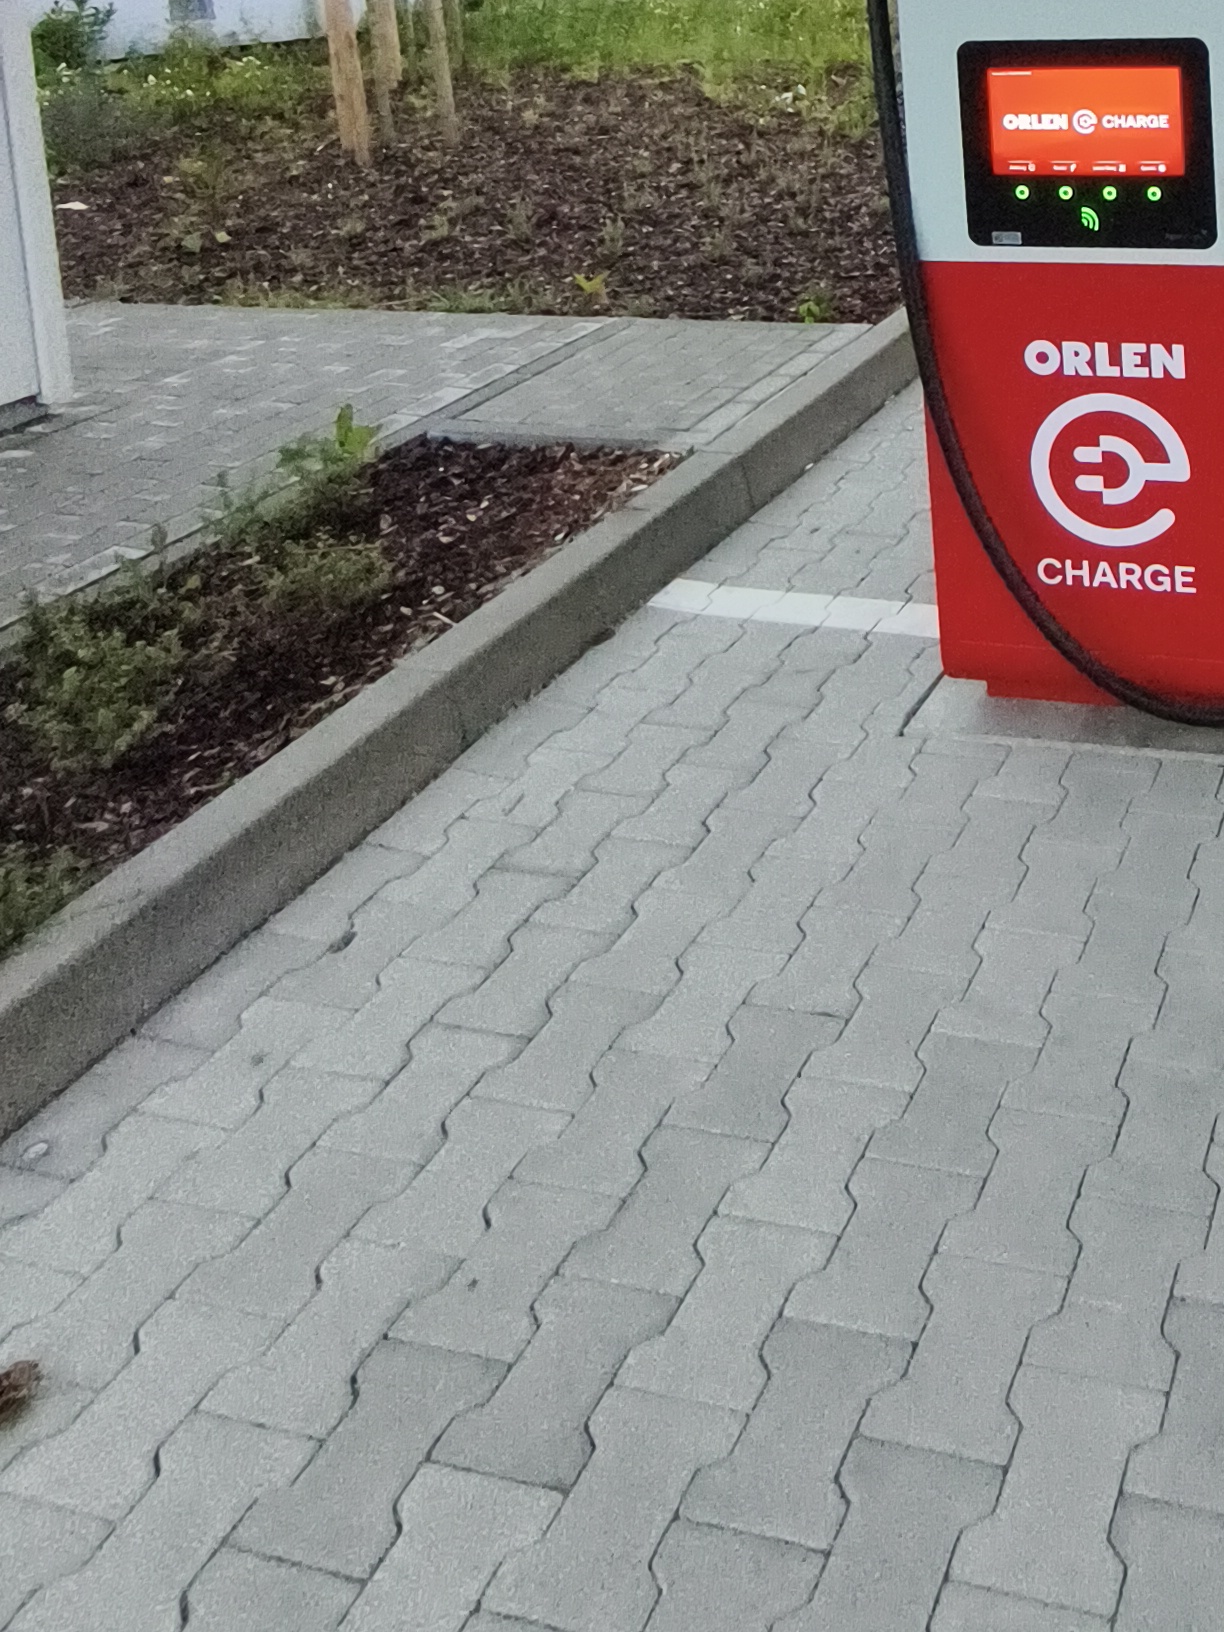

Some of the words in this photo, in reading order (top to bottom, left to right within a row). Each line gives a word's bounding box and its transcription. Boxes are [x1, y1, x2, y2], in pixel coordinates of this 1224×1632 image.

[1002, 113, 1069, 131] ORLEN
[1101, 114, 1170, 129] CHARGE
[1023, 339, 1187, 380] ORLEN
[1036, 557, 1197, 594] CHARGE
